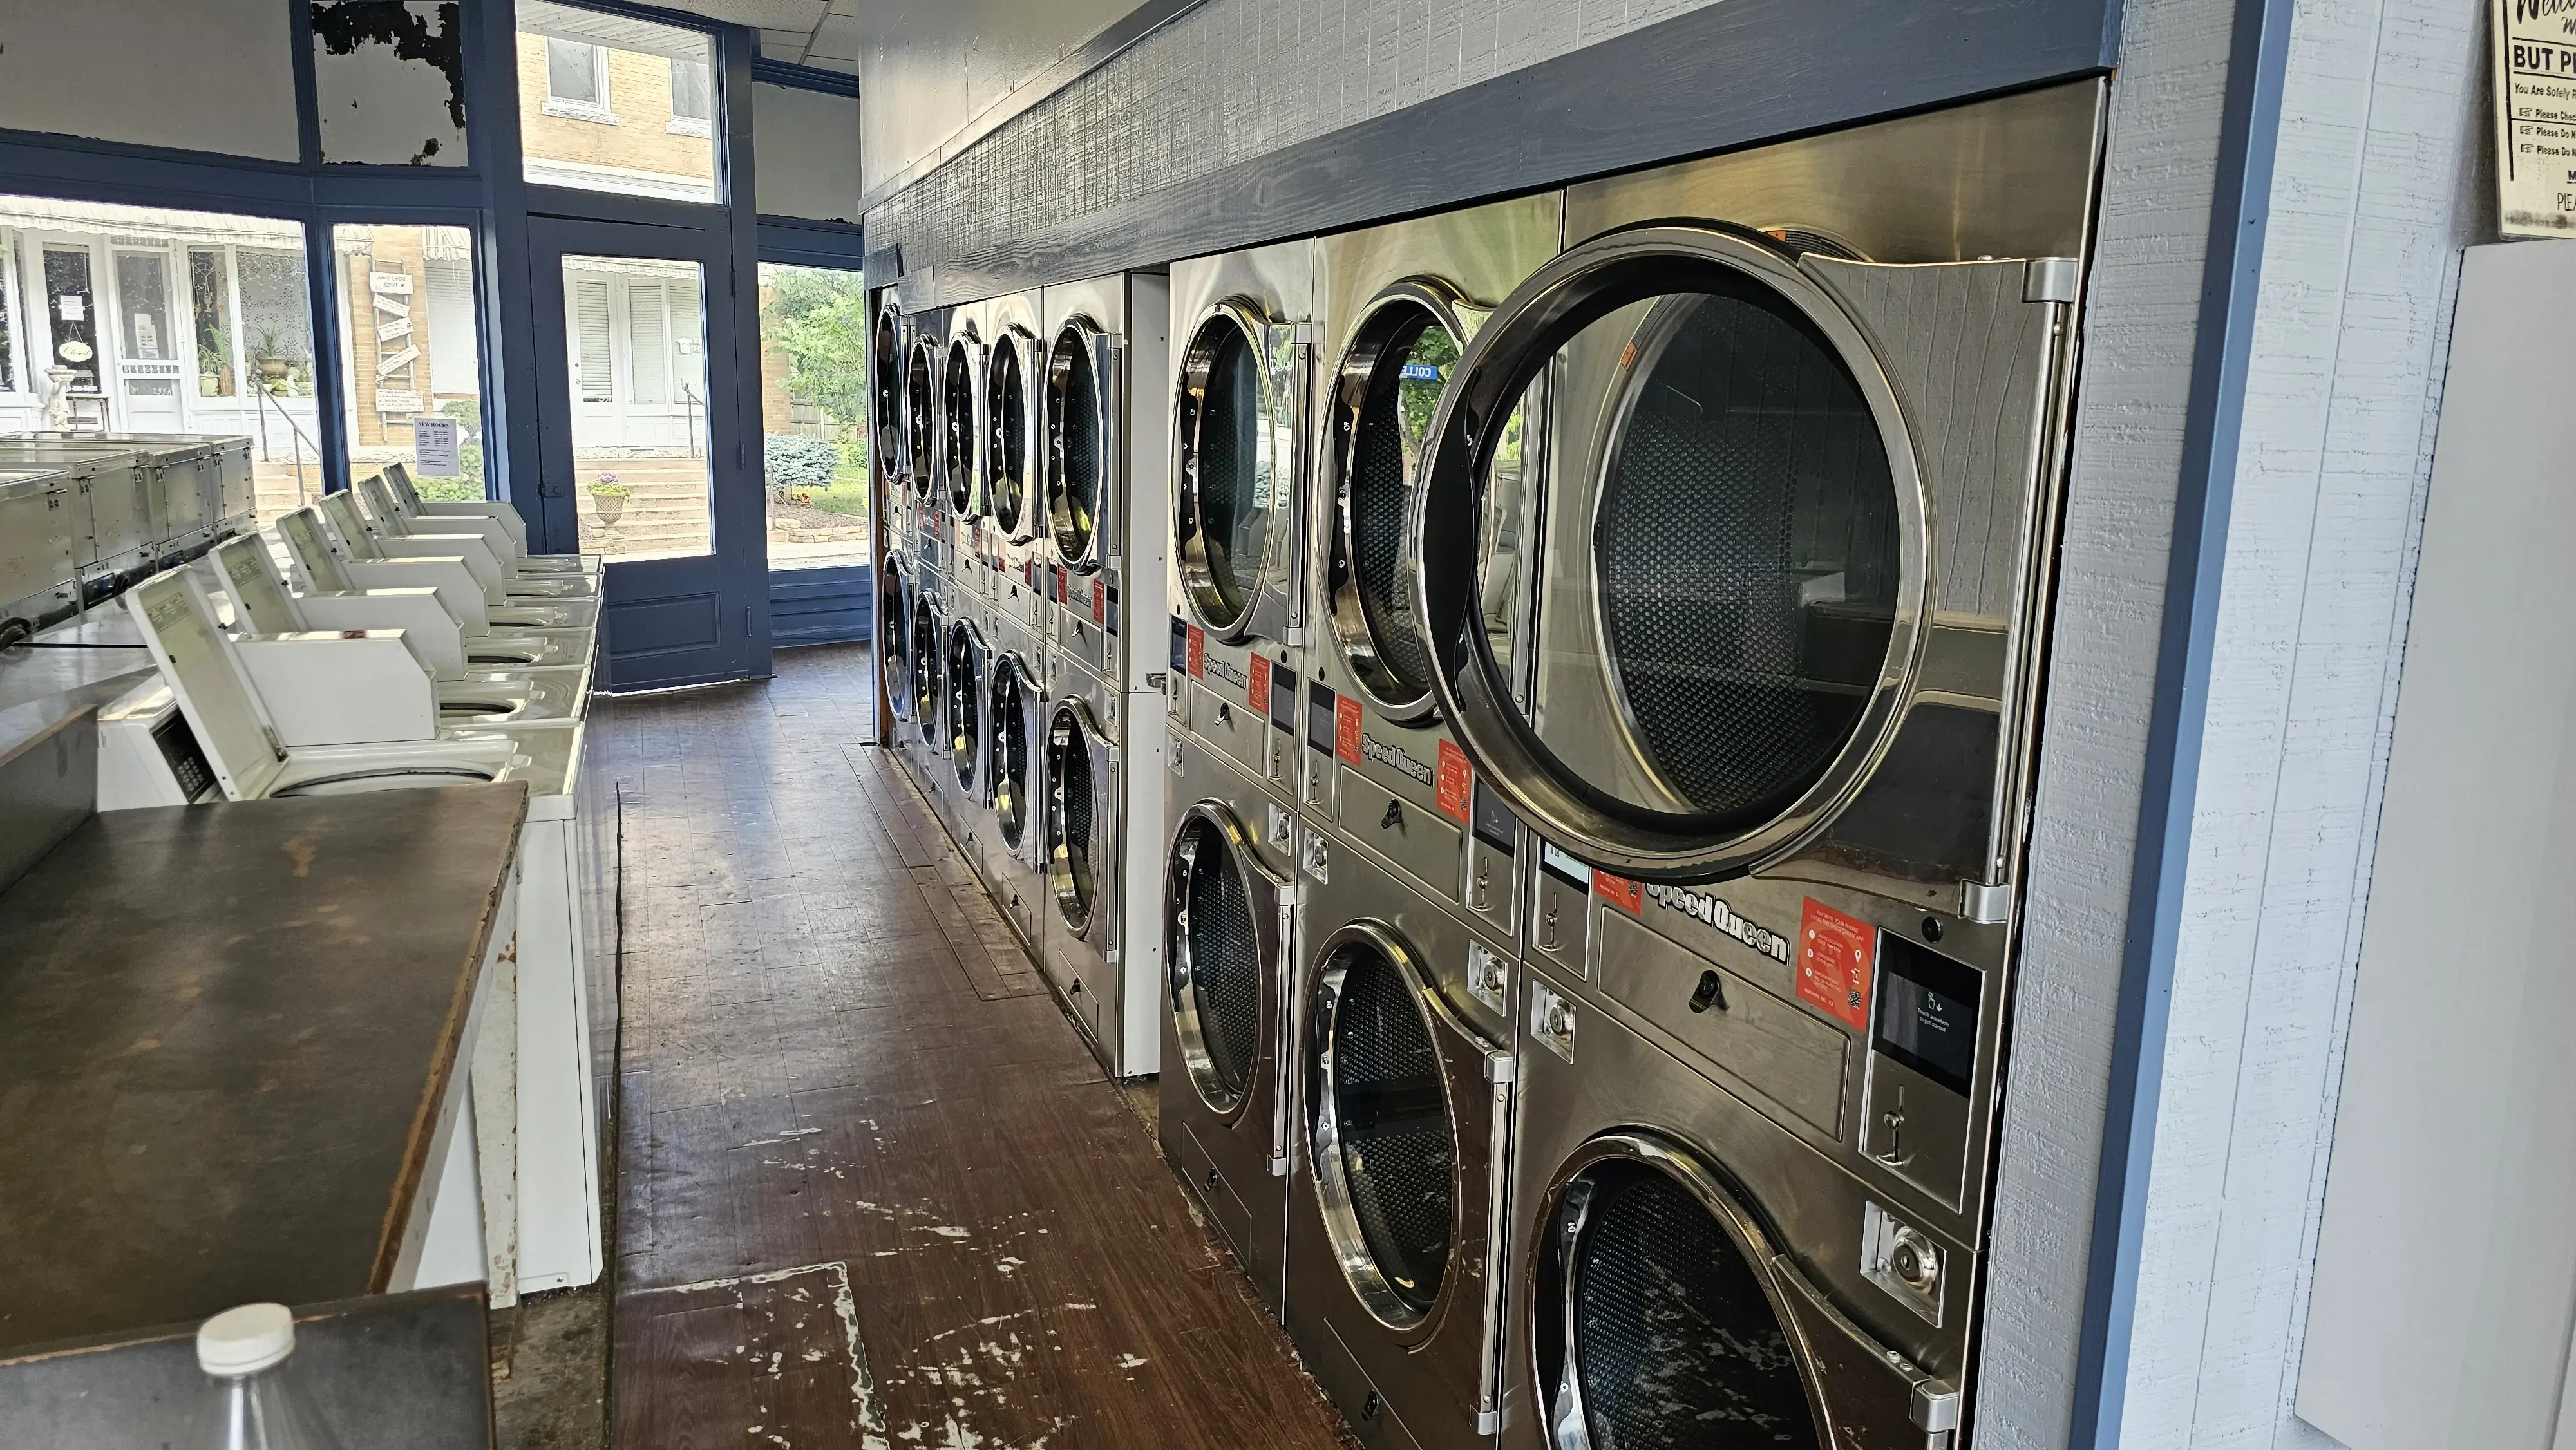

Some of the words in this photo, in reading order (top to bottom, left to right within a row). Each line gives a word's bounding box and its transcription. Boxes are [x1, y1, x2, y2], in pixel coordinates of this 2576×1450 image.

[2514, 44, 2553, 70] BUT
[2514, 83, 2528, 94] You
[2531, 85, 2544, 95] Are
[2546, 86, 2570, 100] Solely
[2535, 108, 2558, 119] Please
[2536, 126, 2559, 137] Please
[2561, 129, 2570, 138] Do
[2537, 145, 2559, 156] Please
[2562, 147, 2570, 156] Do
[1204, 652, 1225, 678] Speed
[1224, 661, 1248, 690] Queen
[1361, 732, 1396, 767] Speed
[1396, 748, 1434, 787] Queen
[1645, 882, 1714, 927] Speed
[1713, 898, 1790, 966] Queen
